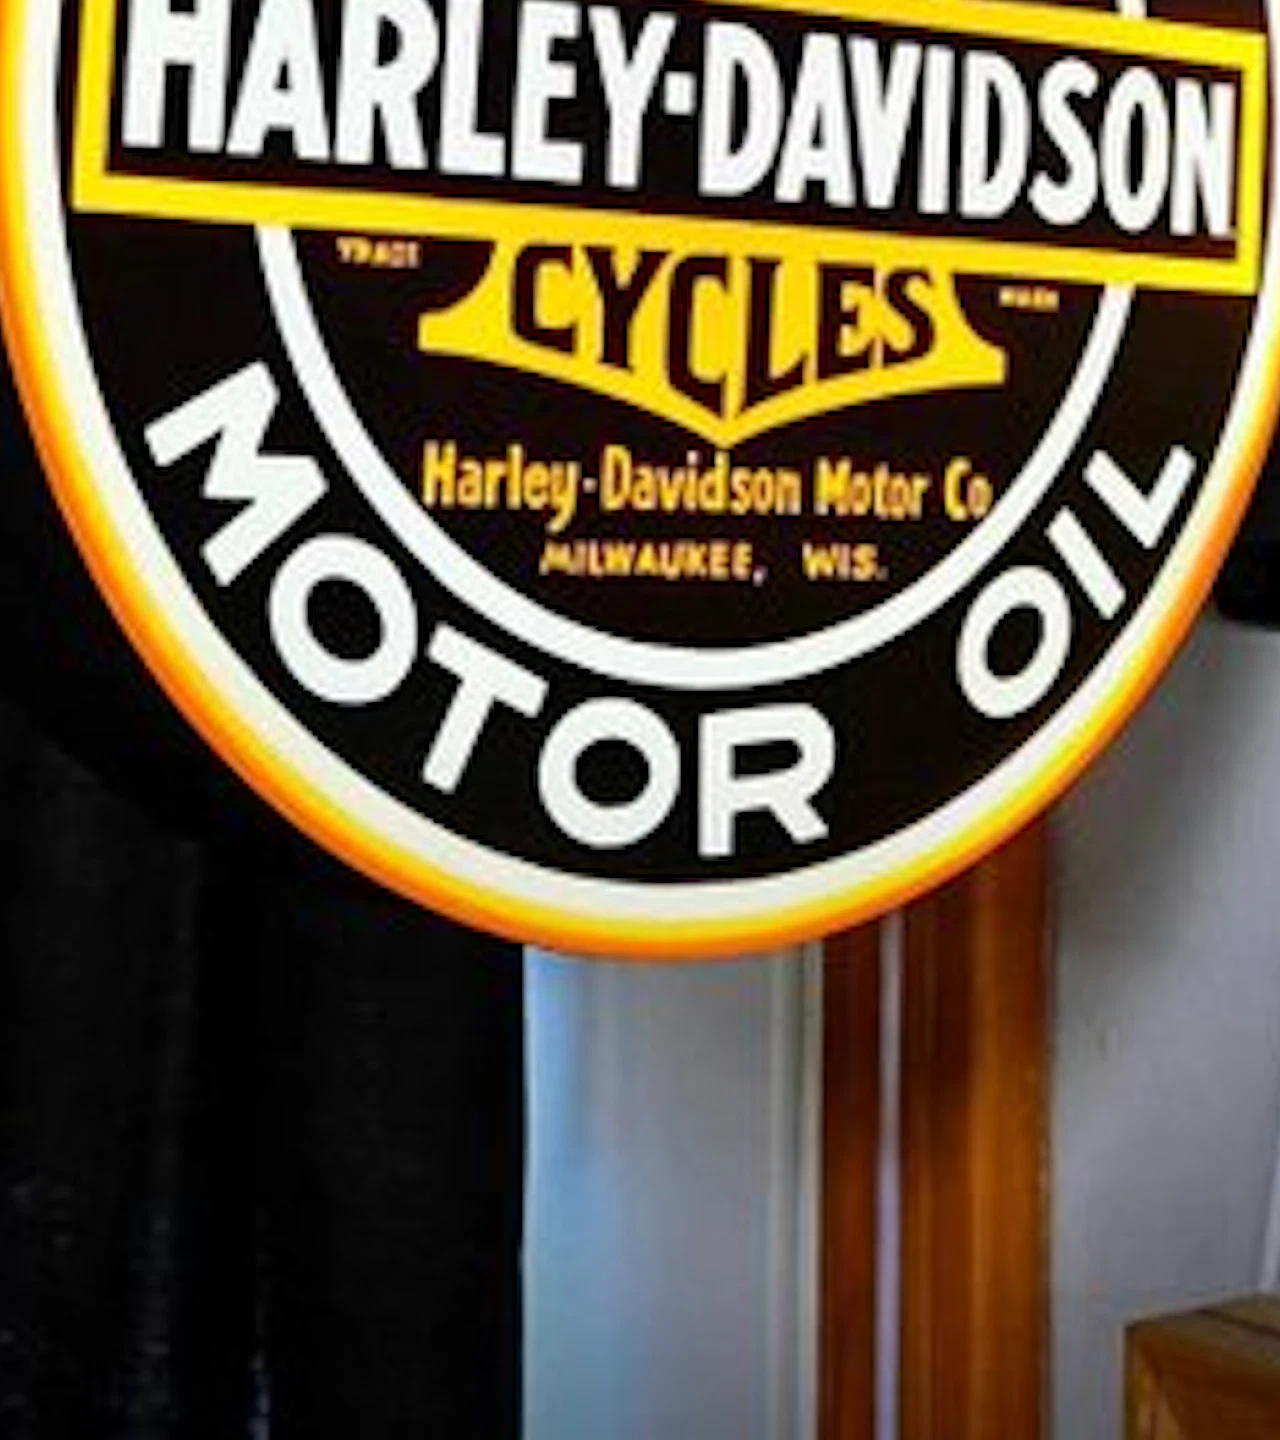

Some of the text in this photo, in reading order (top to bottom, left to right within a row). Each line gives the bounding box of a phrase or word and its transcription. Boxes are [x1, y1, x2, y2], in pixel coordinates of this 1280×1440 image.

[510, 242, 937, 392] CYCLES
[423, 439, 802, 534] Harley-Davidson
[815, 456, 928, 519] Motor
[145, 362, 1197, 857] MOTOR OIL
[540, 541, 888, 585] MILWAUKEE, WIS.
